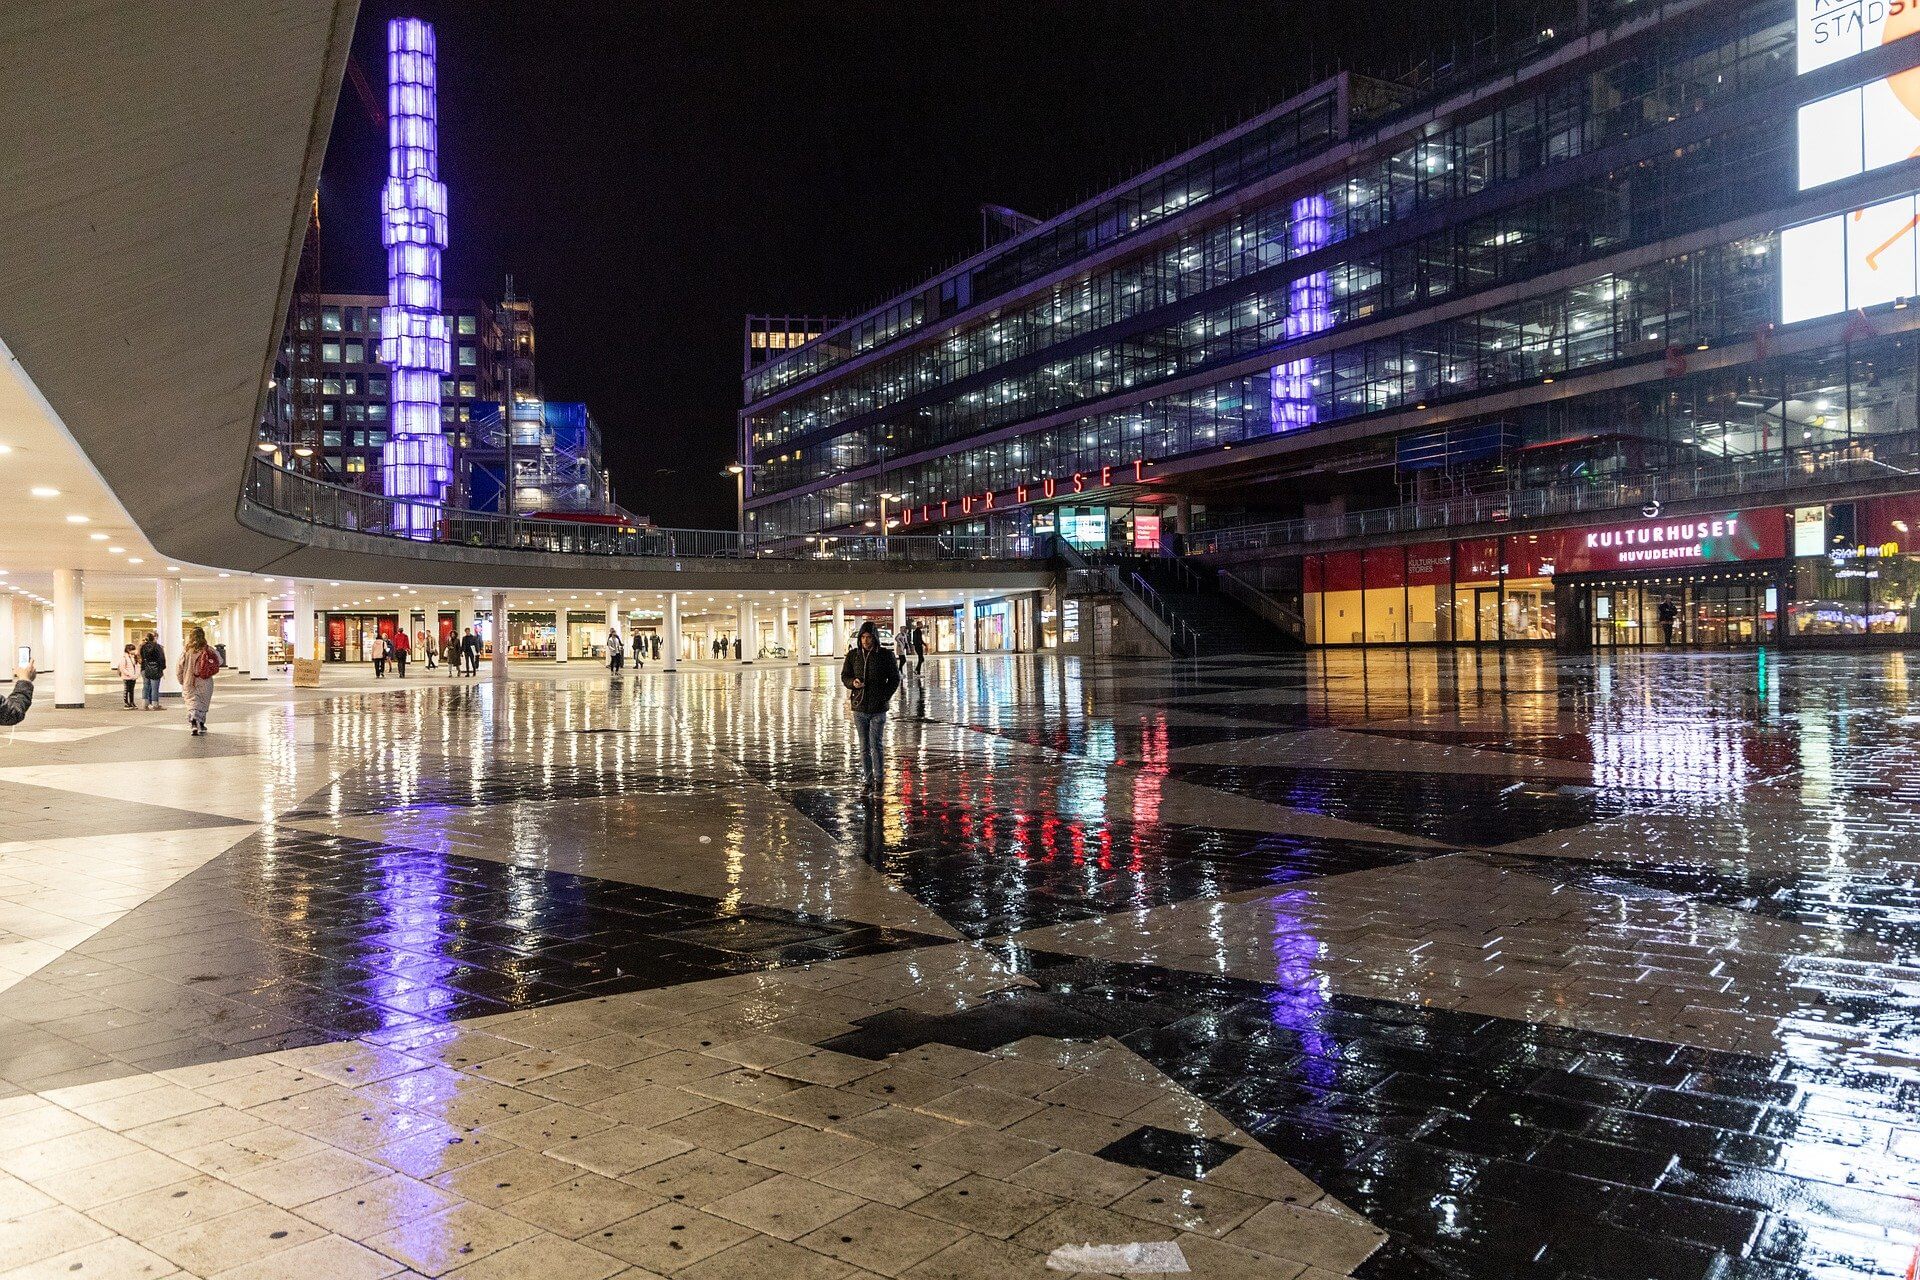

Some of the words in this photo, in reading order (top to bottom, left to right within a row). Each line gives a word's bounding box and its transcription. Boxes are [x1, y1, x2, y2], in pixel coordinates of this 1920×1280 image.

[886, 459, 1142, 526] ULTURHUSET
[1587, 519, 1737, 548] KULTURHUSET
[1619, 544, 1702, 562] HUVUDENTRÉ
